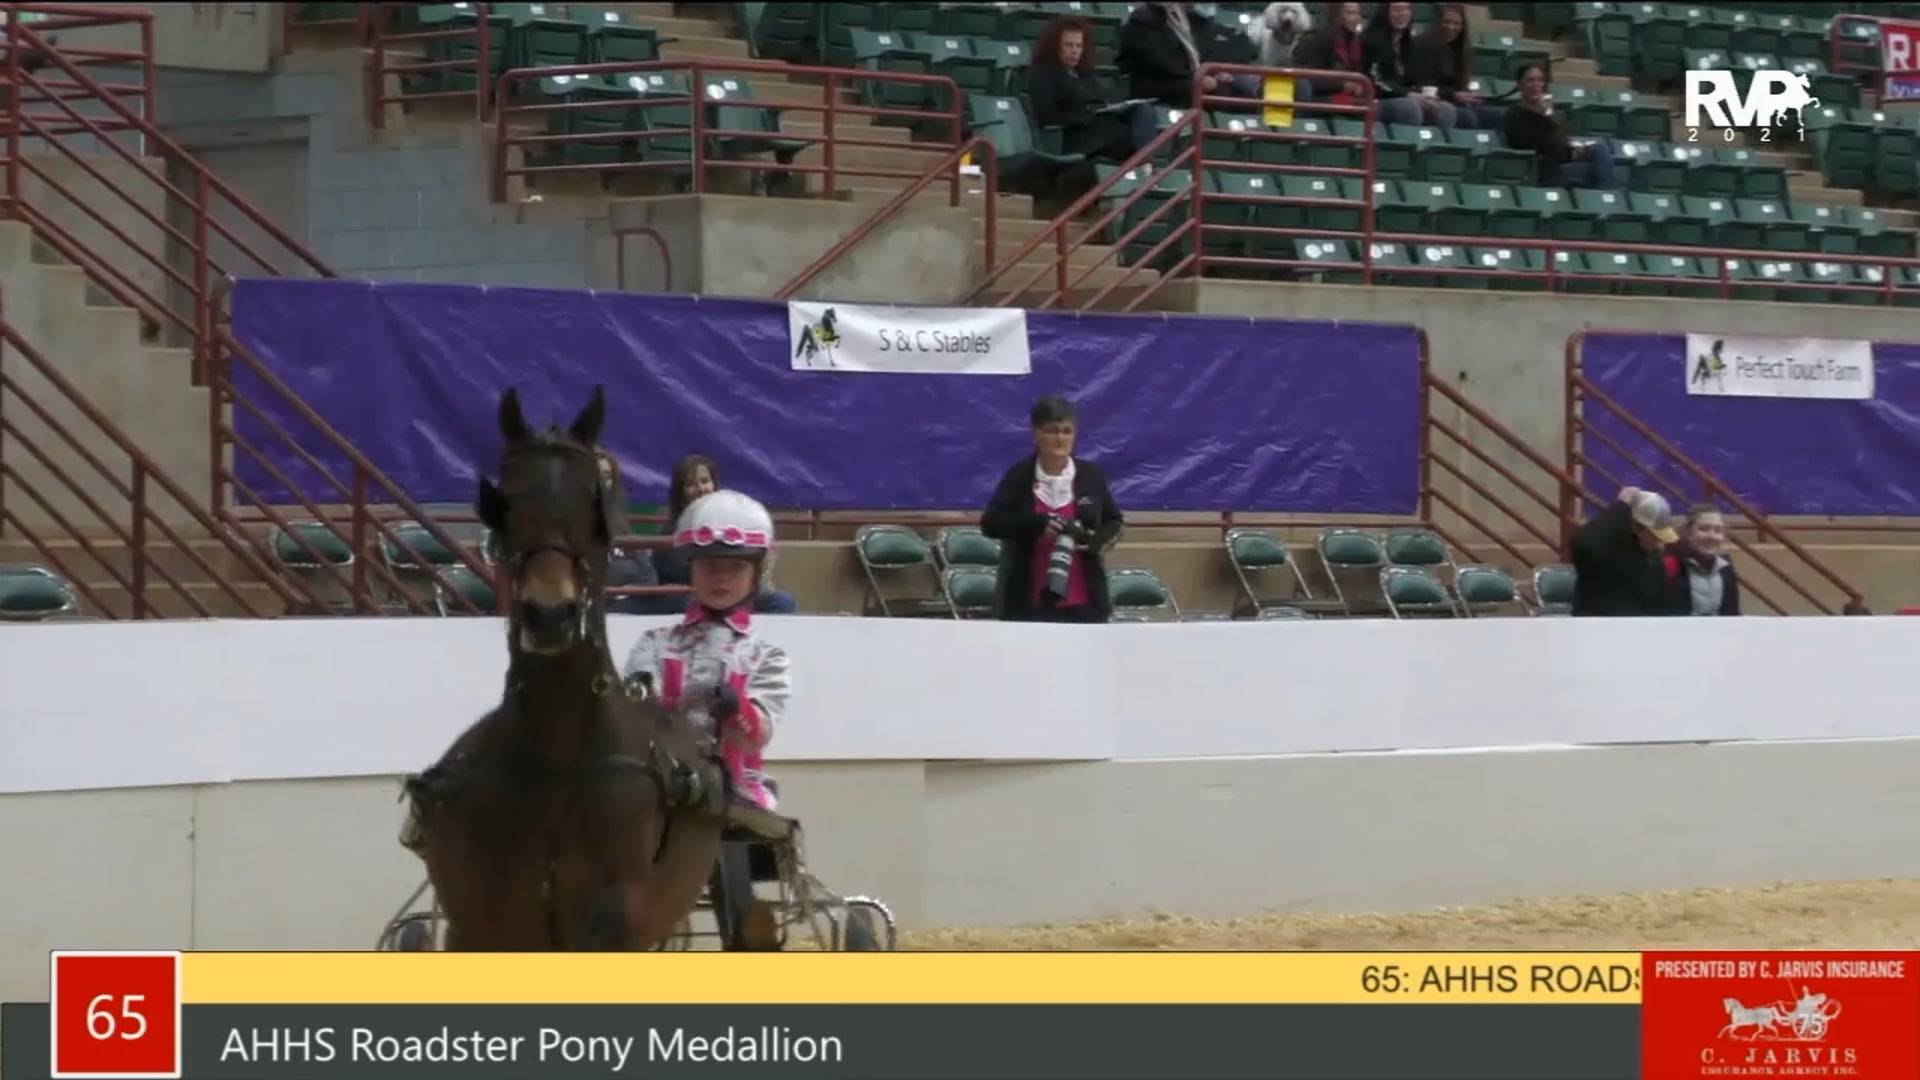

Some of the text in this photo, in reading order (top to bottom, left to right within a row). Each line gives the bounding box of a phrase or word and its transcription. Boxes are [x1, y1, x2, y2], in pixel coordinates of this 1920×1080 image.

[879, 328, 991, 354] S & C Stables
[1735, 355, 1863, 382] Perfect Touch Farm
